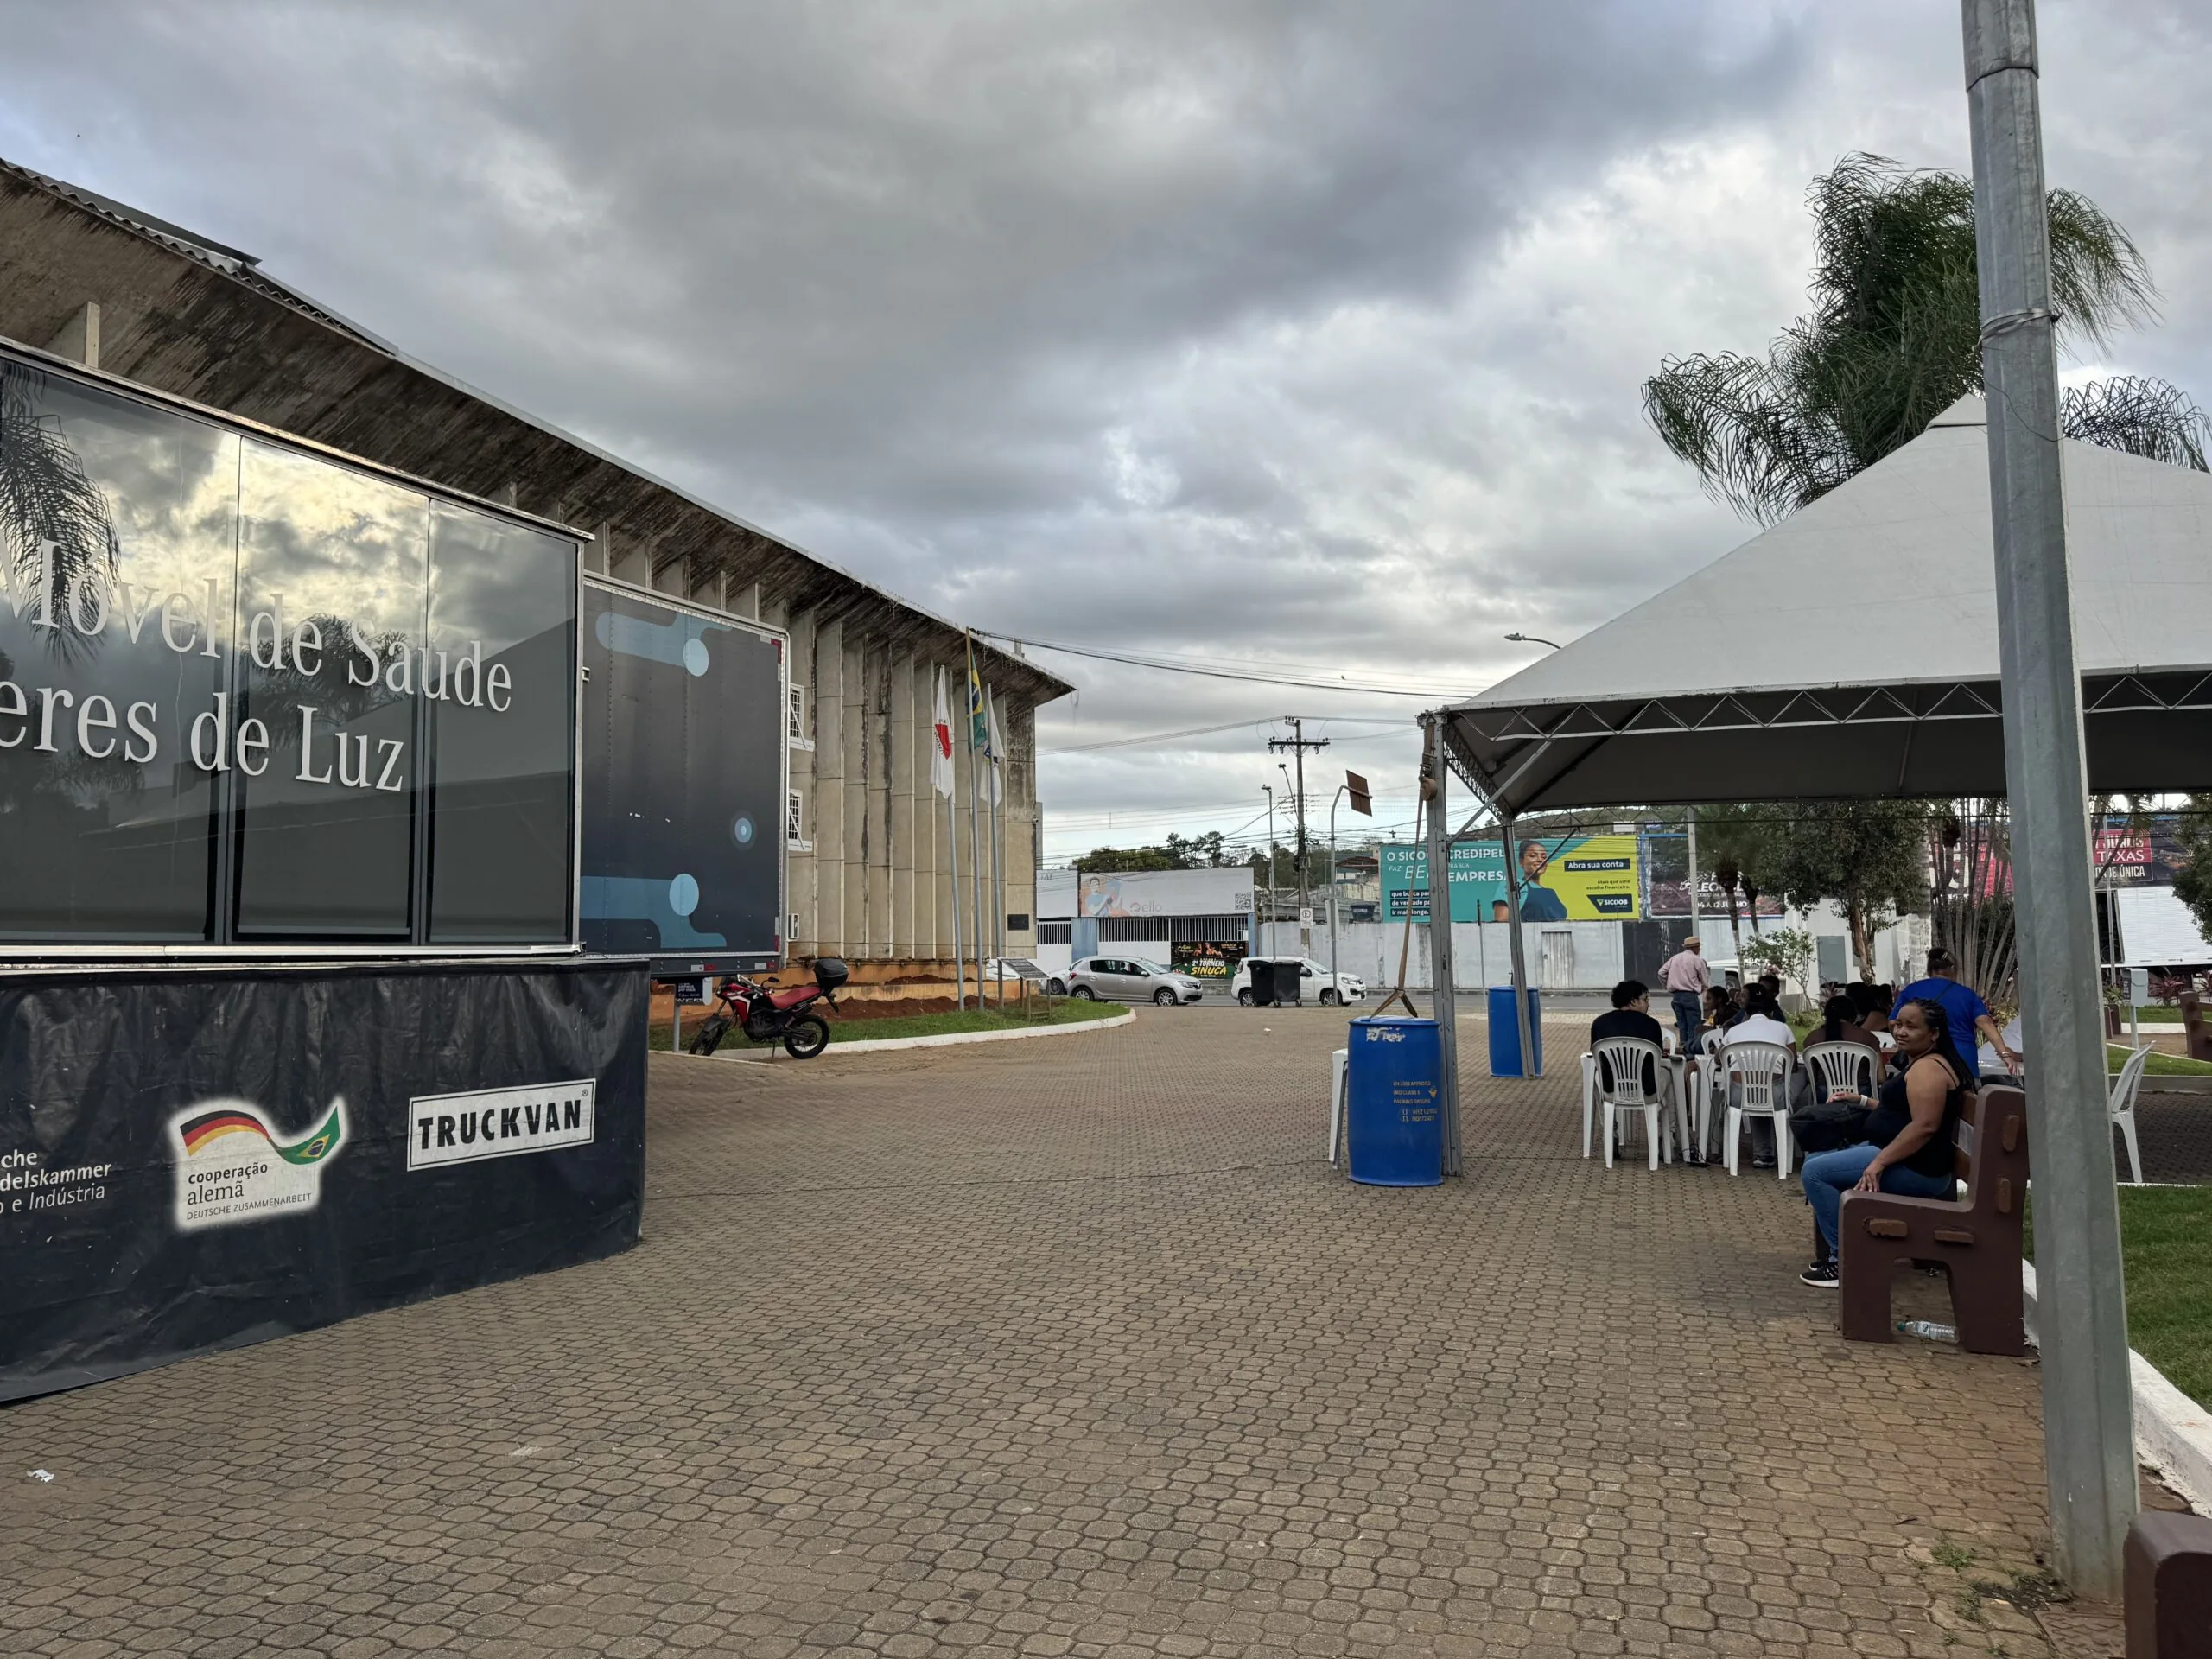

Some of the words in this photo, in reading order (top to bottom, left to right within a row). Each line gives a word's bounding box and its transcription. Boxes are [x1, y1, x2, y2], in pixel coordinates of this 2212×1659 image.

[0, 529, 221, 658] Móvel
[250, 594, 322, 677] de
[348, 614, 512, 713] Saúde
[0, 681, 158, 763] eres
[190, 693, 270, 776] de
[295, 704, 404, 792] Luz
[1387, 851, 1395, 861] O
[2120, 864, 2145, 878] ÚNICA
[1191, 966, 1227, 976] SINUCA
[418, 1099, 582, 1150] TRUCKVAN
[1, 1148, 37, 1168] che
[0, 1163, 111, 1192] delskammer
[188, 1161, 268, 1184] cooperação
[12, 1198, 22, 1212] e
[29, 1182, 105, 1211] Indústria
[187, 1180, 245, 1205] alemã
[187, 1205, 231, 1220] DEUTSCHE
[233, 1192, 312, 1212] ZUSAMMENARBEIT
